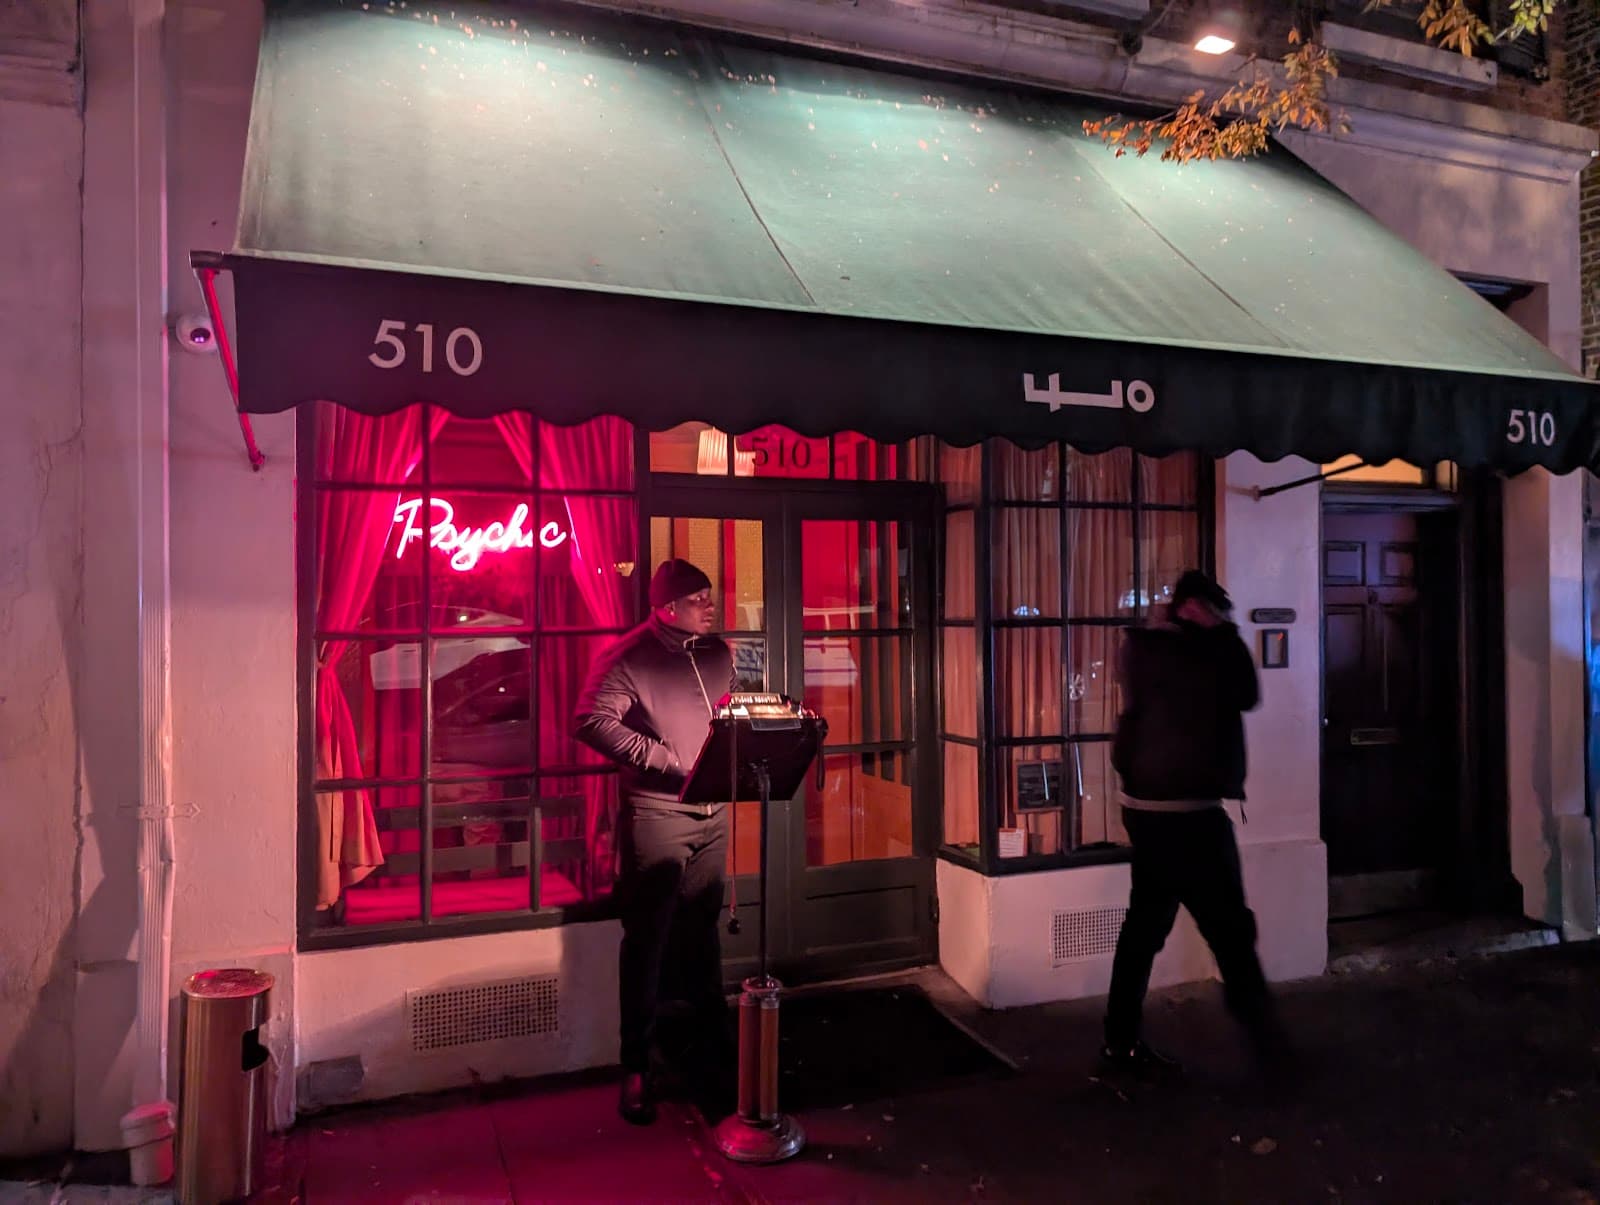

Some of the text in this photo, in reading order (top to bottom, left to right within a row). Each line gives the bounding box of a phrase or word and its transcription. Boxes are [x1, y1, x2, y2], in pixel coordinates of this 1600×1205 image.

[369, 319, 483, 377] 510
[1506, 409, 1556, 447] 510
[752, 437, 811, 469] 510
